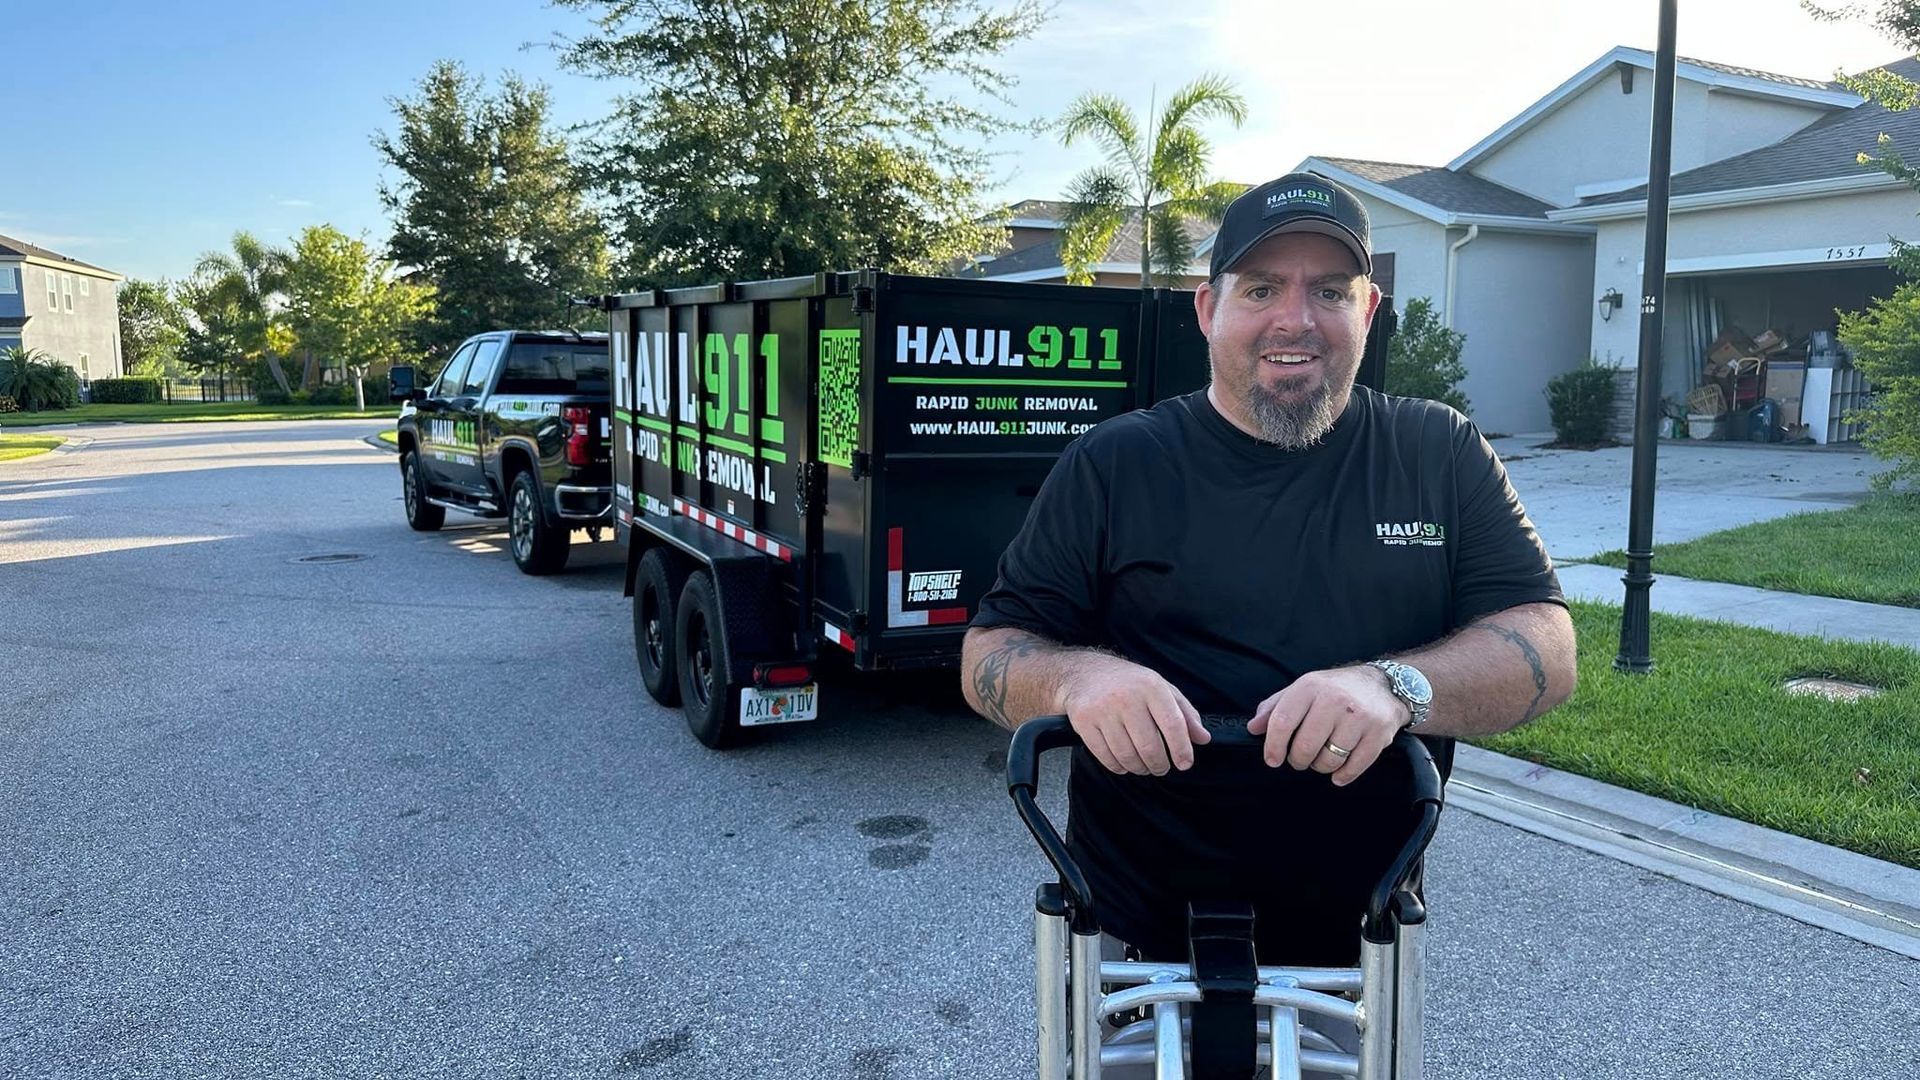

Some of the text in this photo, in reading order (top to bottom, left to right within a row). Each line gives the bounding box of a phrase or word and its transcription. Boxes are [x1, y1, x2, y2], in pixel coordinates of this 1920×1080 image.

[1826, 245, 1865, 260] 7557
[916, 396, 1098, 412] RAPID JUNK REMOVAL
[910, 421, 1098, 436] www.HAUL911JUNK.co
[661, 436, 696, 475] JNK
